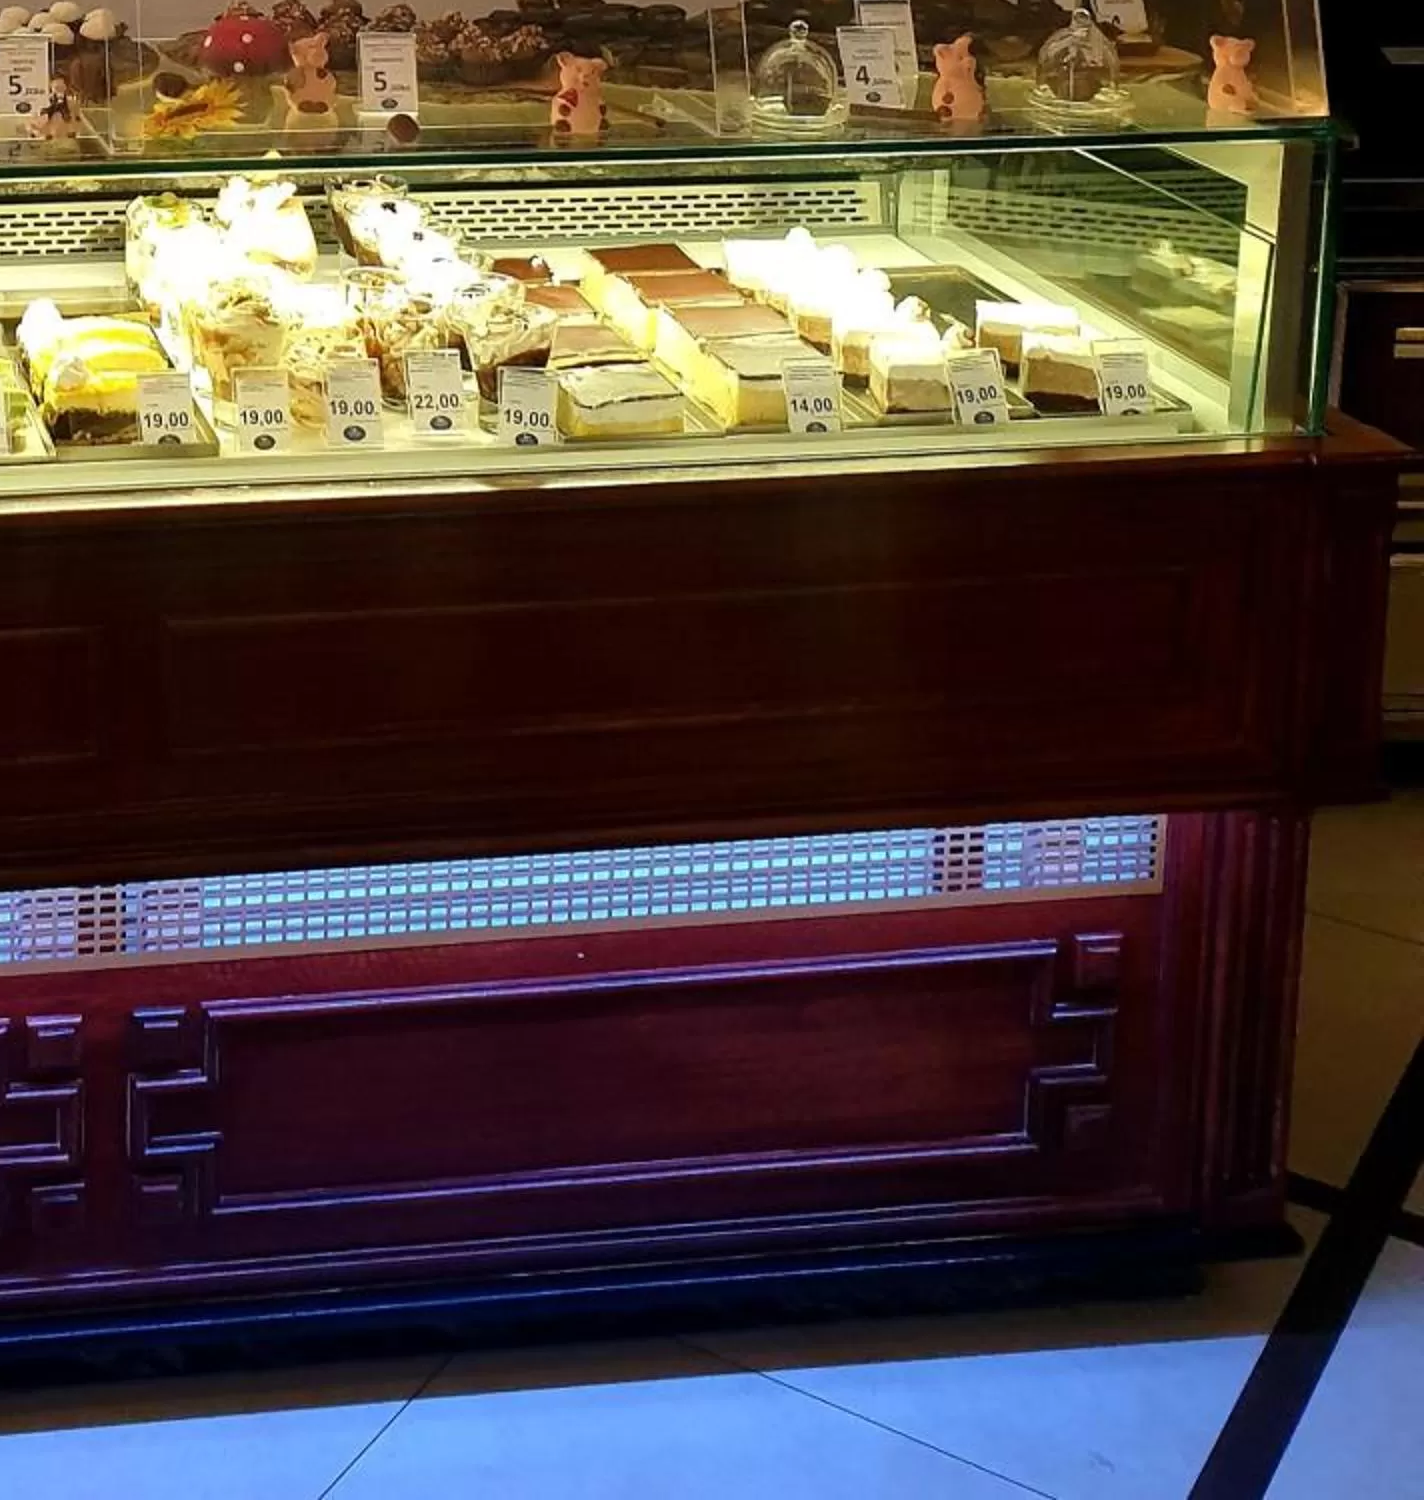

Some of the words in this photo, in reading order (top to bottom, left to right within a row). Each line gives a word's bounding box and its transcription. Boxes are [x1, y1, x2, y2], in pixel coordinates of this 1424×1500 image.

[957, 385, 997, 405] 19,00
[1105, 383, 1146, 400] 19,00
[330, 399, 374, 416] 19,00
[415, 393, 459, 411] 22,00
[790, 397, 833, 415] 14,00
[143, 411, 188, 430] 19,00
[239, 408, 284, 426] 19,00
[504, 409, 549, 428] 19,00
